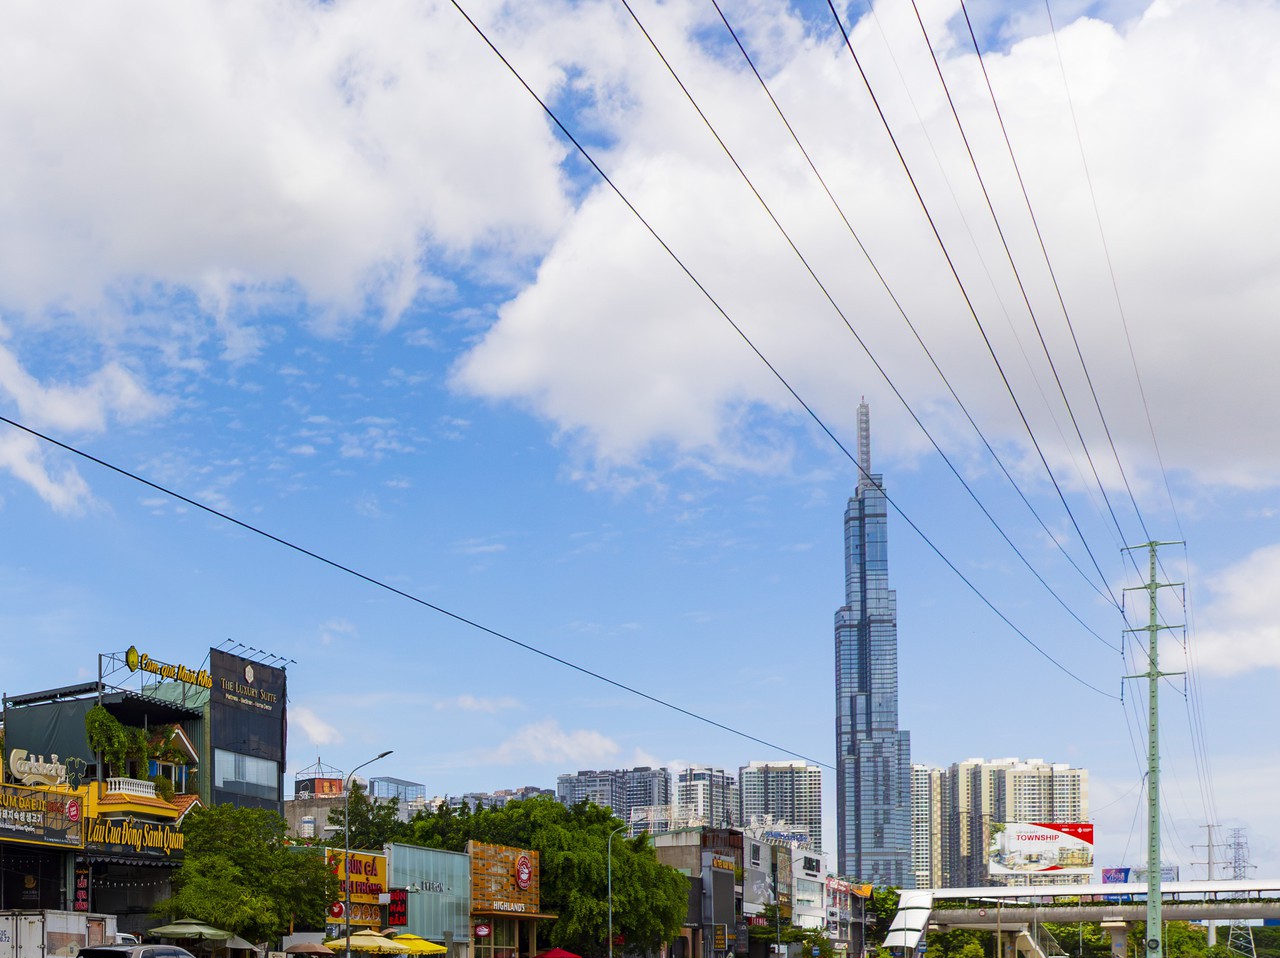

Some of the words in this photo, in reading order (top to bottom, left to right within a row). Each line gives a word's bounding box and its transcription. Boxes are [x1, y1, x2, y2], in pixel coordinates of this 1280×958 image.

[10, 749, 66, 786] Carlsberg
[105, 820, 121, 844] Cua
[345, 853, 362, 875] BÚN
[365, 856, 379, 877] CÁ
[390, 890, 406, 901] BÚN
